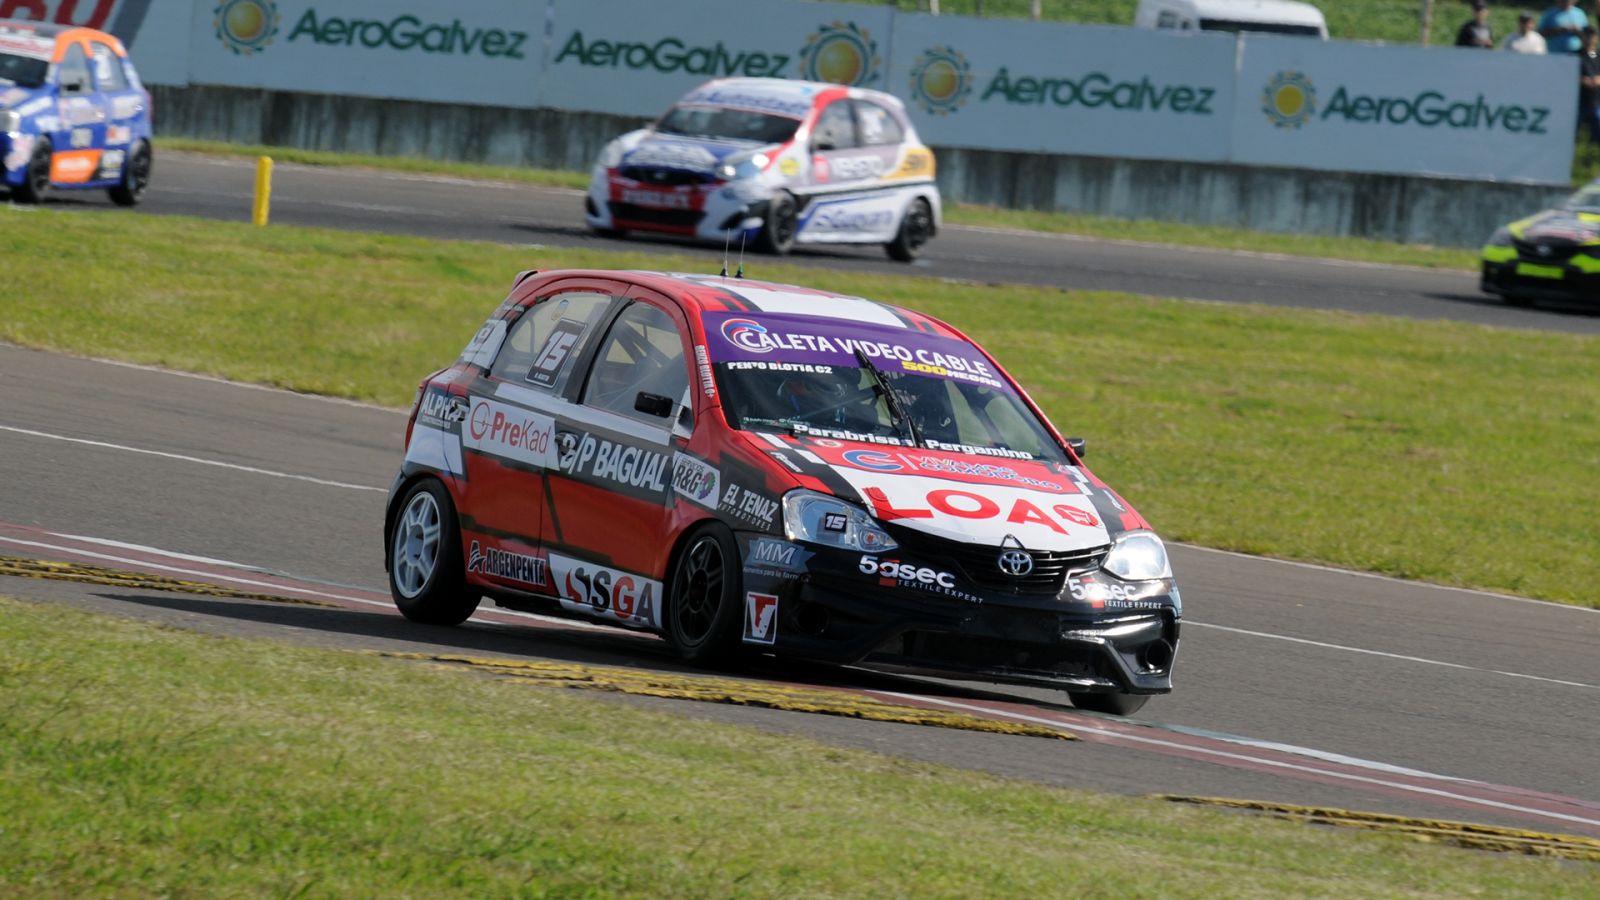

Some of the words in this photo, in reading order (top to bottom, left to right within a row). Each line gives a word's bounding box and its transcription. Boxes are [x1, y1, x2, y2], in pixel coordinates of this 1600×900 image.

[287, 8, 528, 59] AeroGalvez
[554, 29, 790, 79] AeroGalvez
[981, 66, 1216, 115] AeroGalvez
[1321, 84, 1552, 134] AeroGalvez
[534, 330, 579, 371] 15
[739, 331, 838, 354] CALETA
[834, 336, 914, 362] VIDEO
[915, 348, 993, 378] CABLE
[489, 410, 552, 454] PreKad
[925, 439, 1034, 460] Pergamino
[592, 439, 669, 493] BAGUAL
[674, 464, 703, 495] R&G
[722, 483, 740, 506] EL
[739, 488, 779, 523] TENAZ
[825, 514, 847, 529] 15
[485, 547, 548, 587] ARGENPENTA
[755, 541, 797, 565] MM
[858, 554, 956, 588] 5asec
[898, 578, 942, 593] TEXTILE
[944, 587, 984, 604] EXPERT
[1104, 600, 1133, 609] TEXTILE
[1134, 601, 1163, 610] EXPERT
